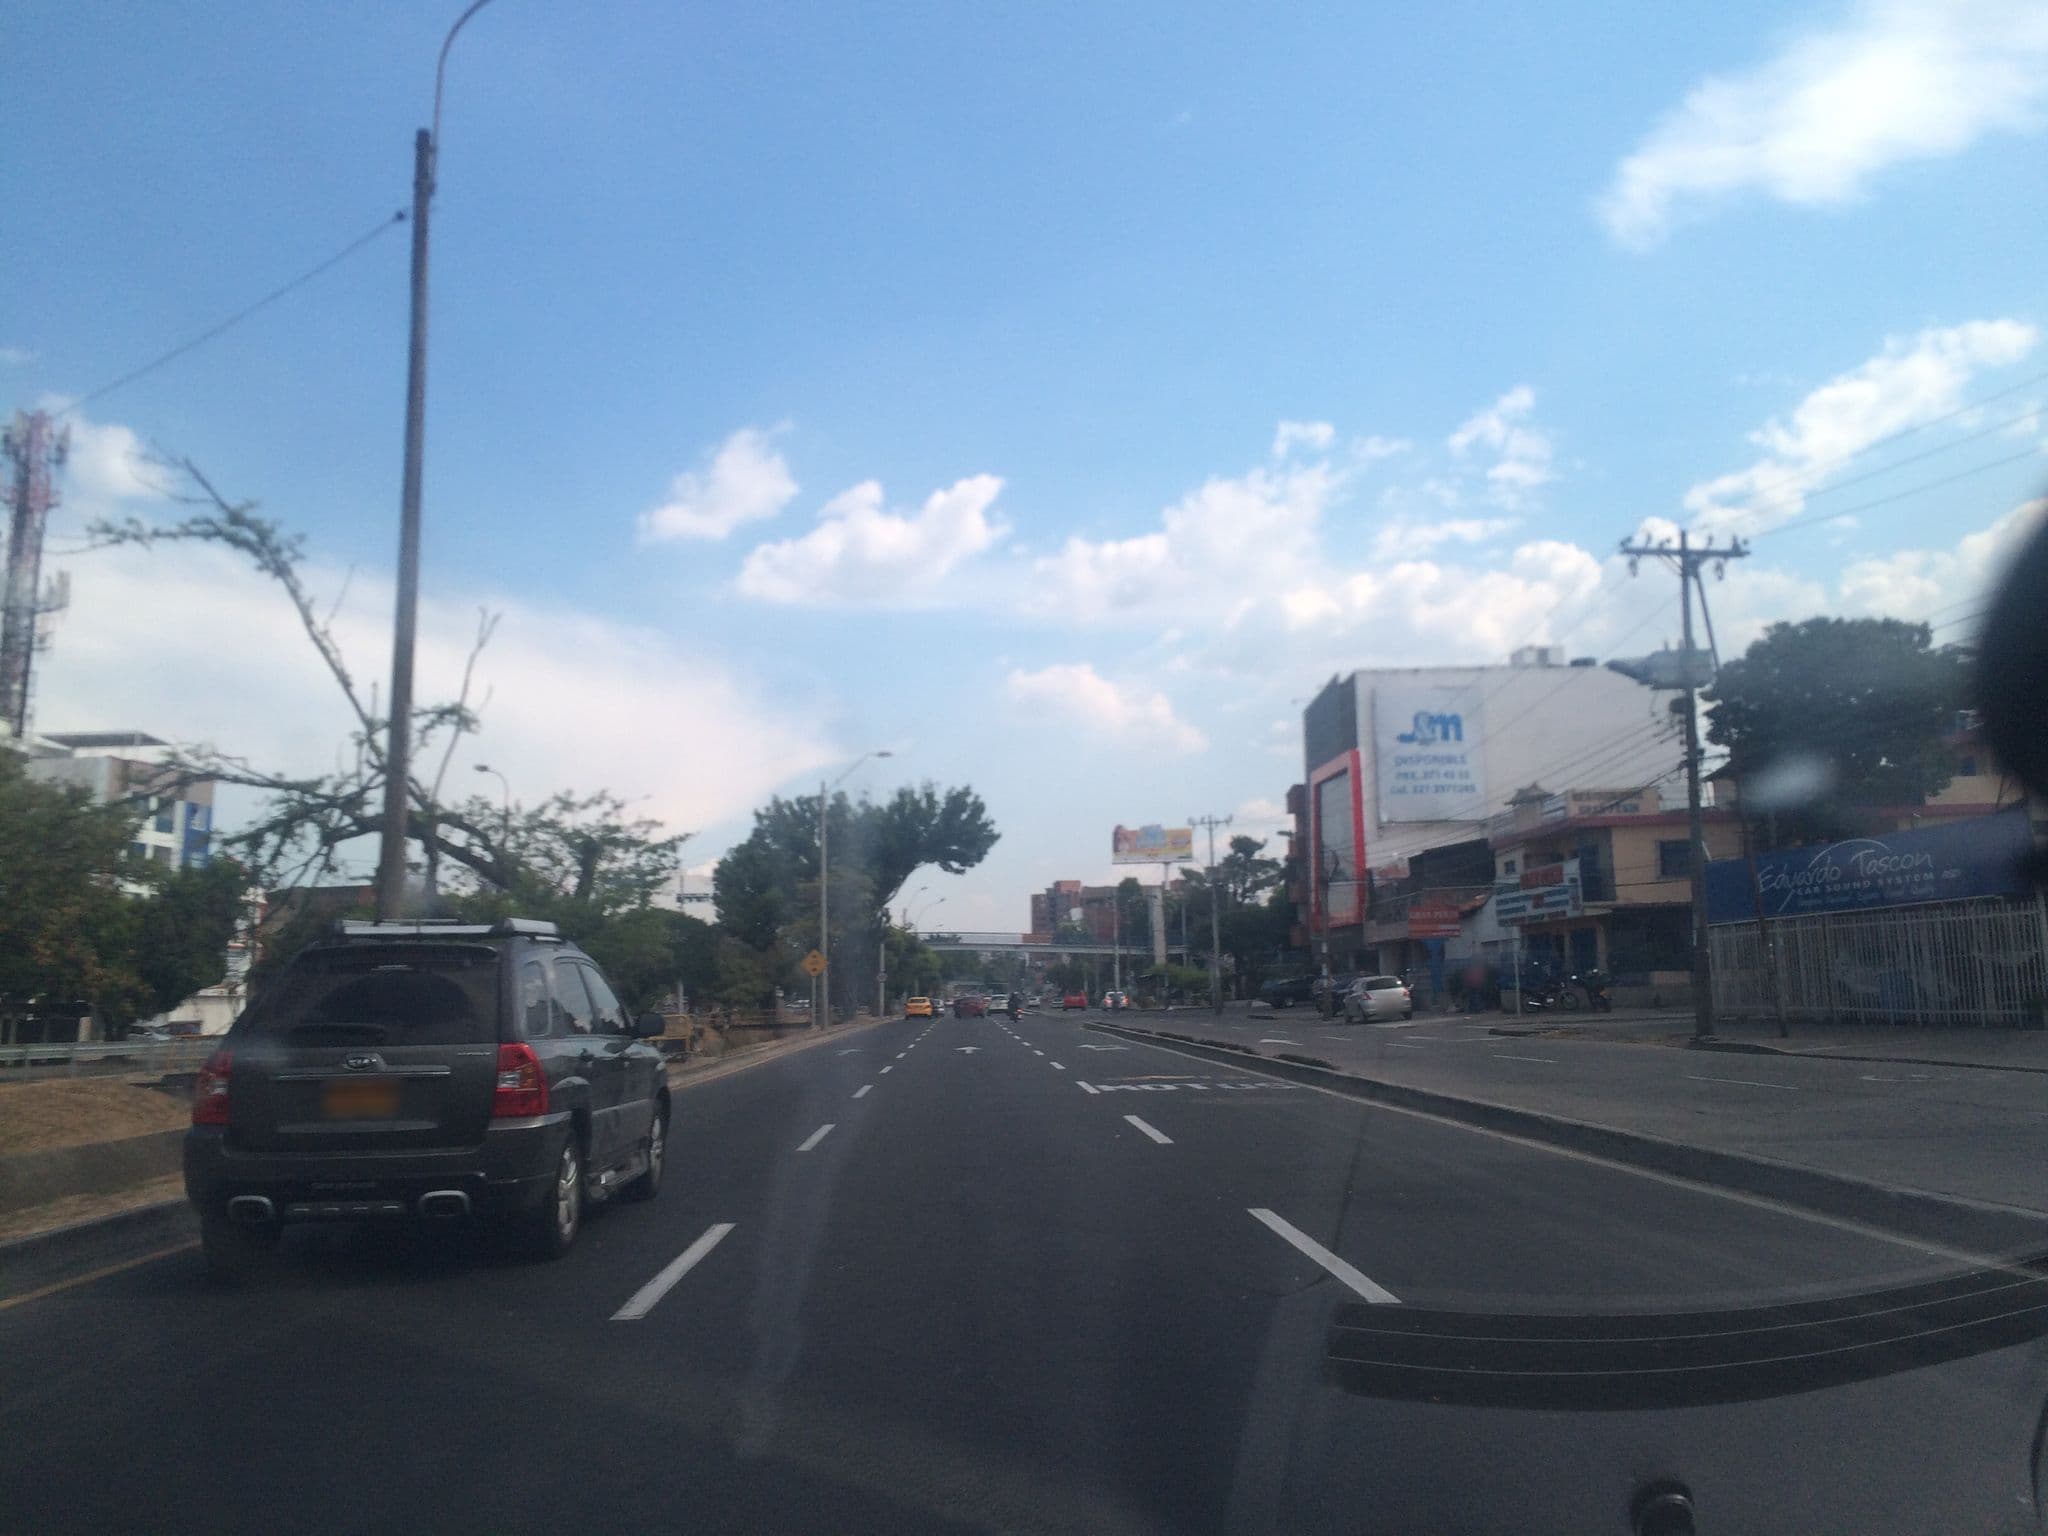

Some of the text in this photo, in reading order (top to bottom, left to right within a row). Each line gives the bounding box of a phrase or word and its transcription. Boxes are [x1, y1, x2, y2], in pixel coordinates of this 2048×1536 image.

[1758, 855, 1842, 893] Eduardo
[1796, 885, 1821, 897] CAR
[1824, 880, 1872, 894] SOUND
[1877, 871, 1935, 887] SYSTEM
